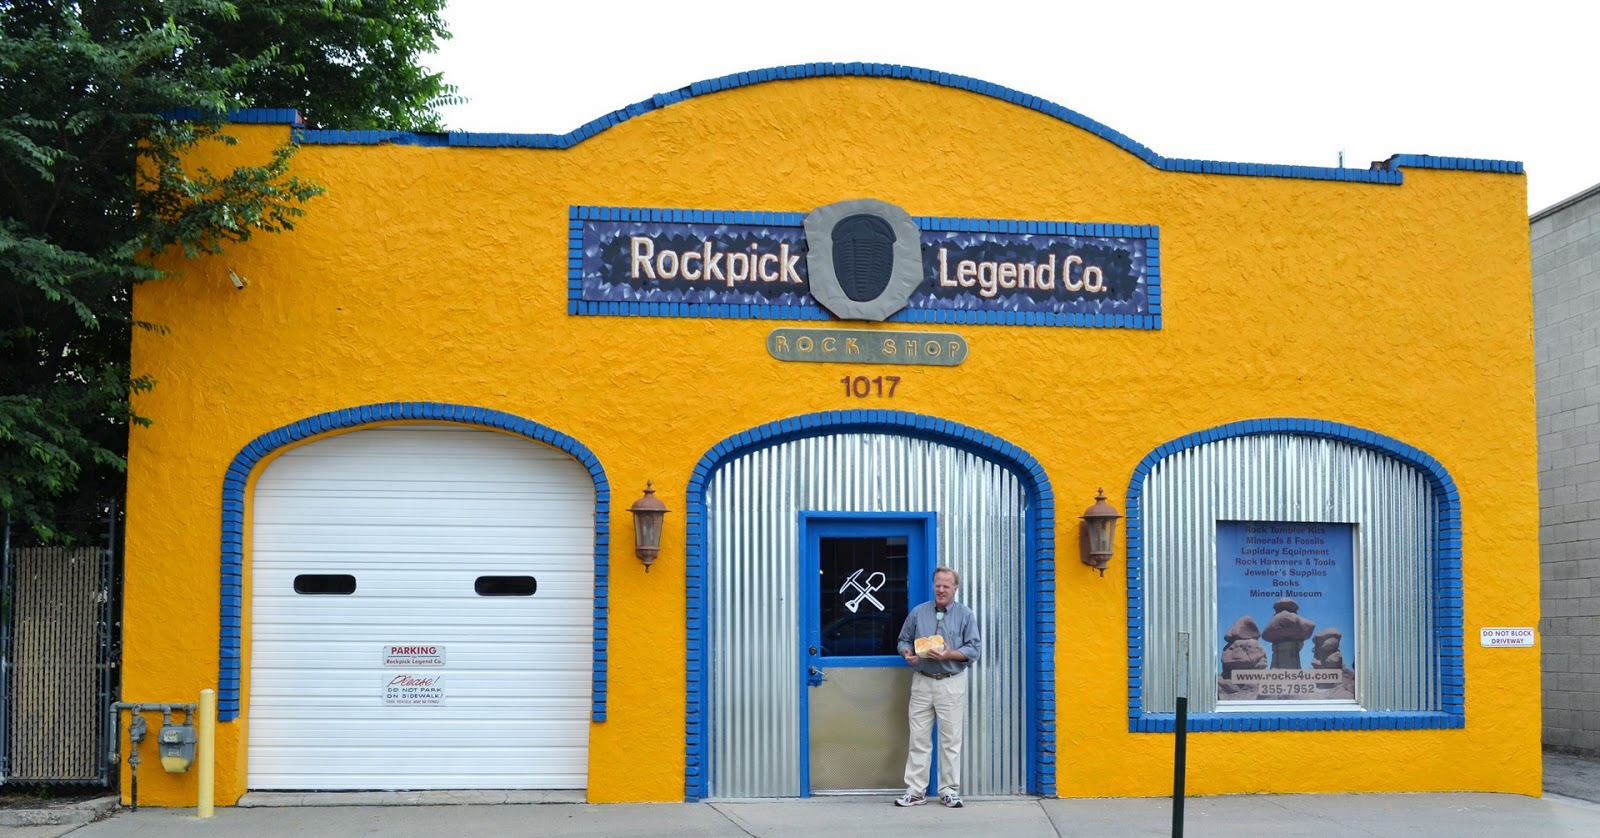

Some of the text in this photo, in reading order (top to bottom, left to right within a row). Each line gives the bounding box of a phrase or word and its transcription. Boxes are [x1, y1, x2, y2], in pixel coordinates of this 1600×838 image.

[630, 236, 1108, 297] Rockpick Legend Co.
[775, 335, 960, 358] ROCK SHOP
[840, 375, 901, 398] 1017
[1245, 526, 1326, 534] Rock Tumbler Kits
[1241, 547, 1329, 556] Lapidary Equipment
[1235, 558, 1336, 566] Rock Hammers & Tools
[1244, 568, 1327, 578] Jeweler's Supplies
[1272, 579, 1299, 587] Books
[1250, 589, 1322, 597] Mineral Museum
[391, 646, 437, 655] PARKING
[387, 675, 440, 687] Please!
[1236, 671, 1338, 681] www.rocks4u.com
[1261, 684, 1315, 694] 355-7952
